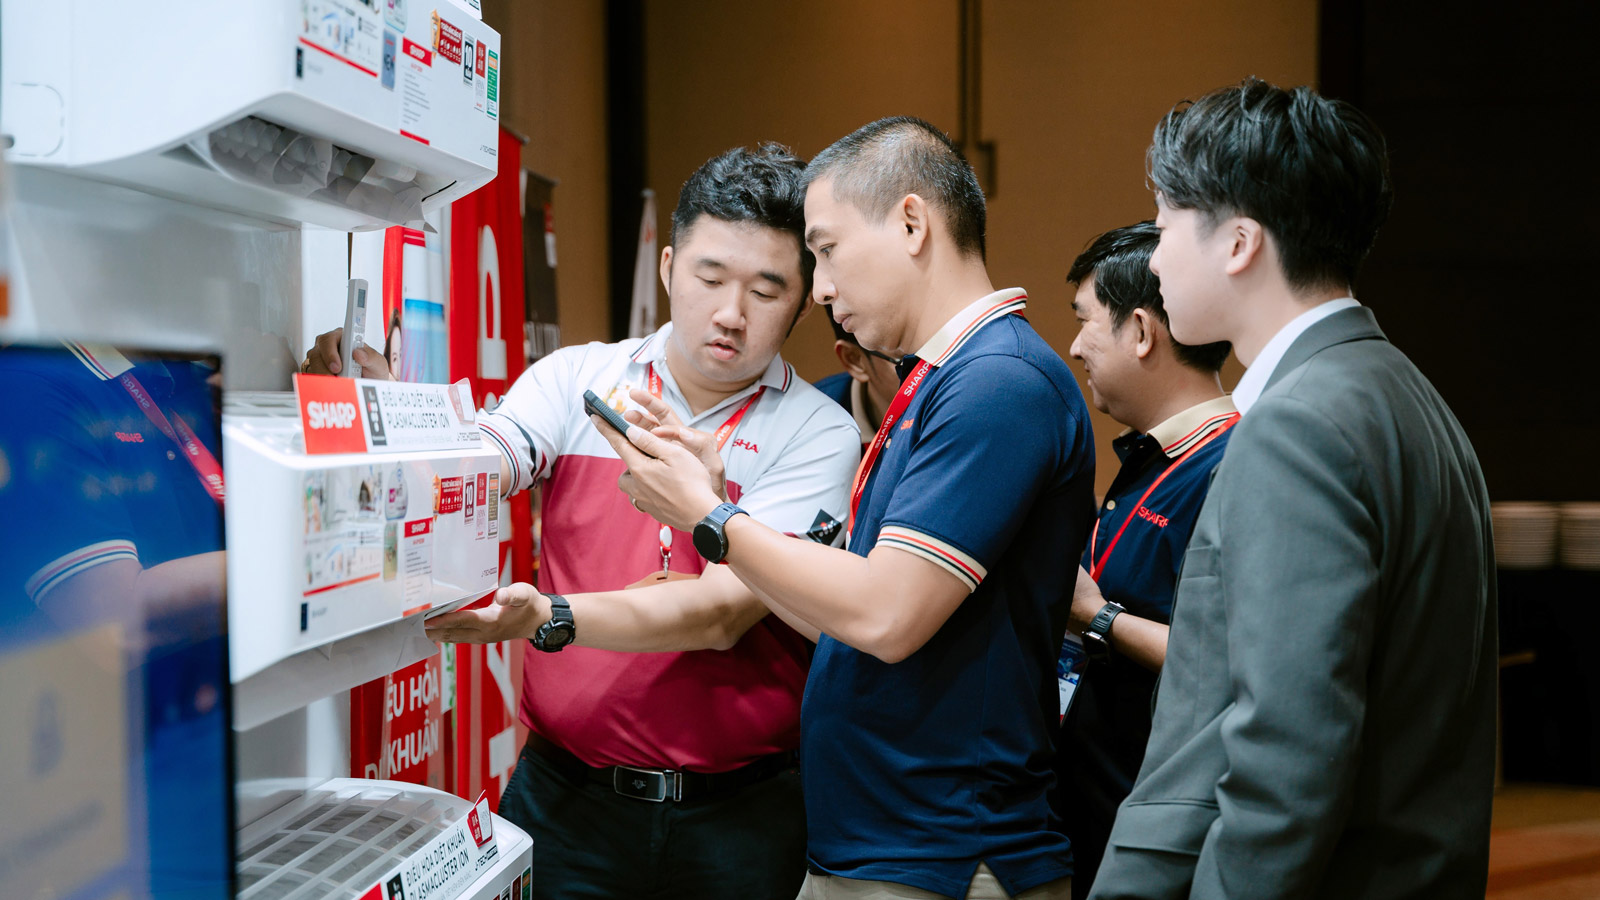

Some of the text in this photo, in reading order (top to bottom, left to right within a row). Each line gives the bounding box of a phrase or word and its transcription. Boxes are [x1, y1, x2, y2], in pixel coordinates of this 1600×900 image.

[903, 362, 930, 397] SHARP
[307, 401, 356, 429] SHARP
[874, 414, 894, 449] SHARP
[466, 484, 473, 506] 10
[409, 662, 439, 712] HÒA
[386, 709, 439, 779] KHUẨN
[458, 848, 470, 870] ION
